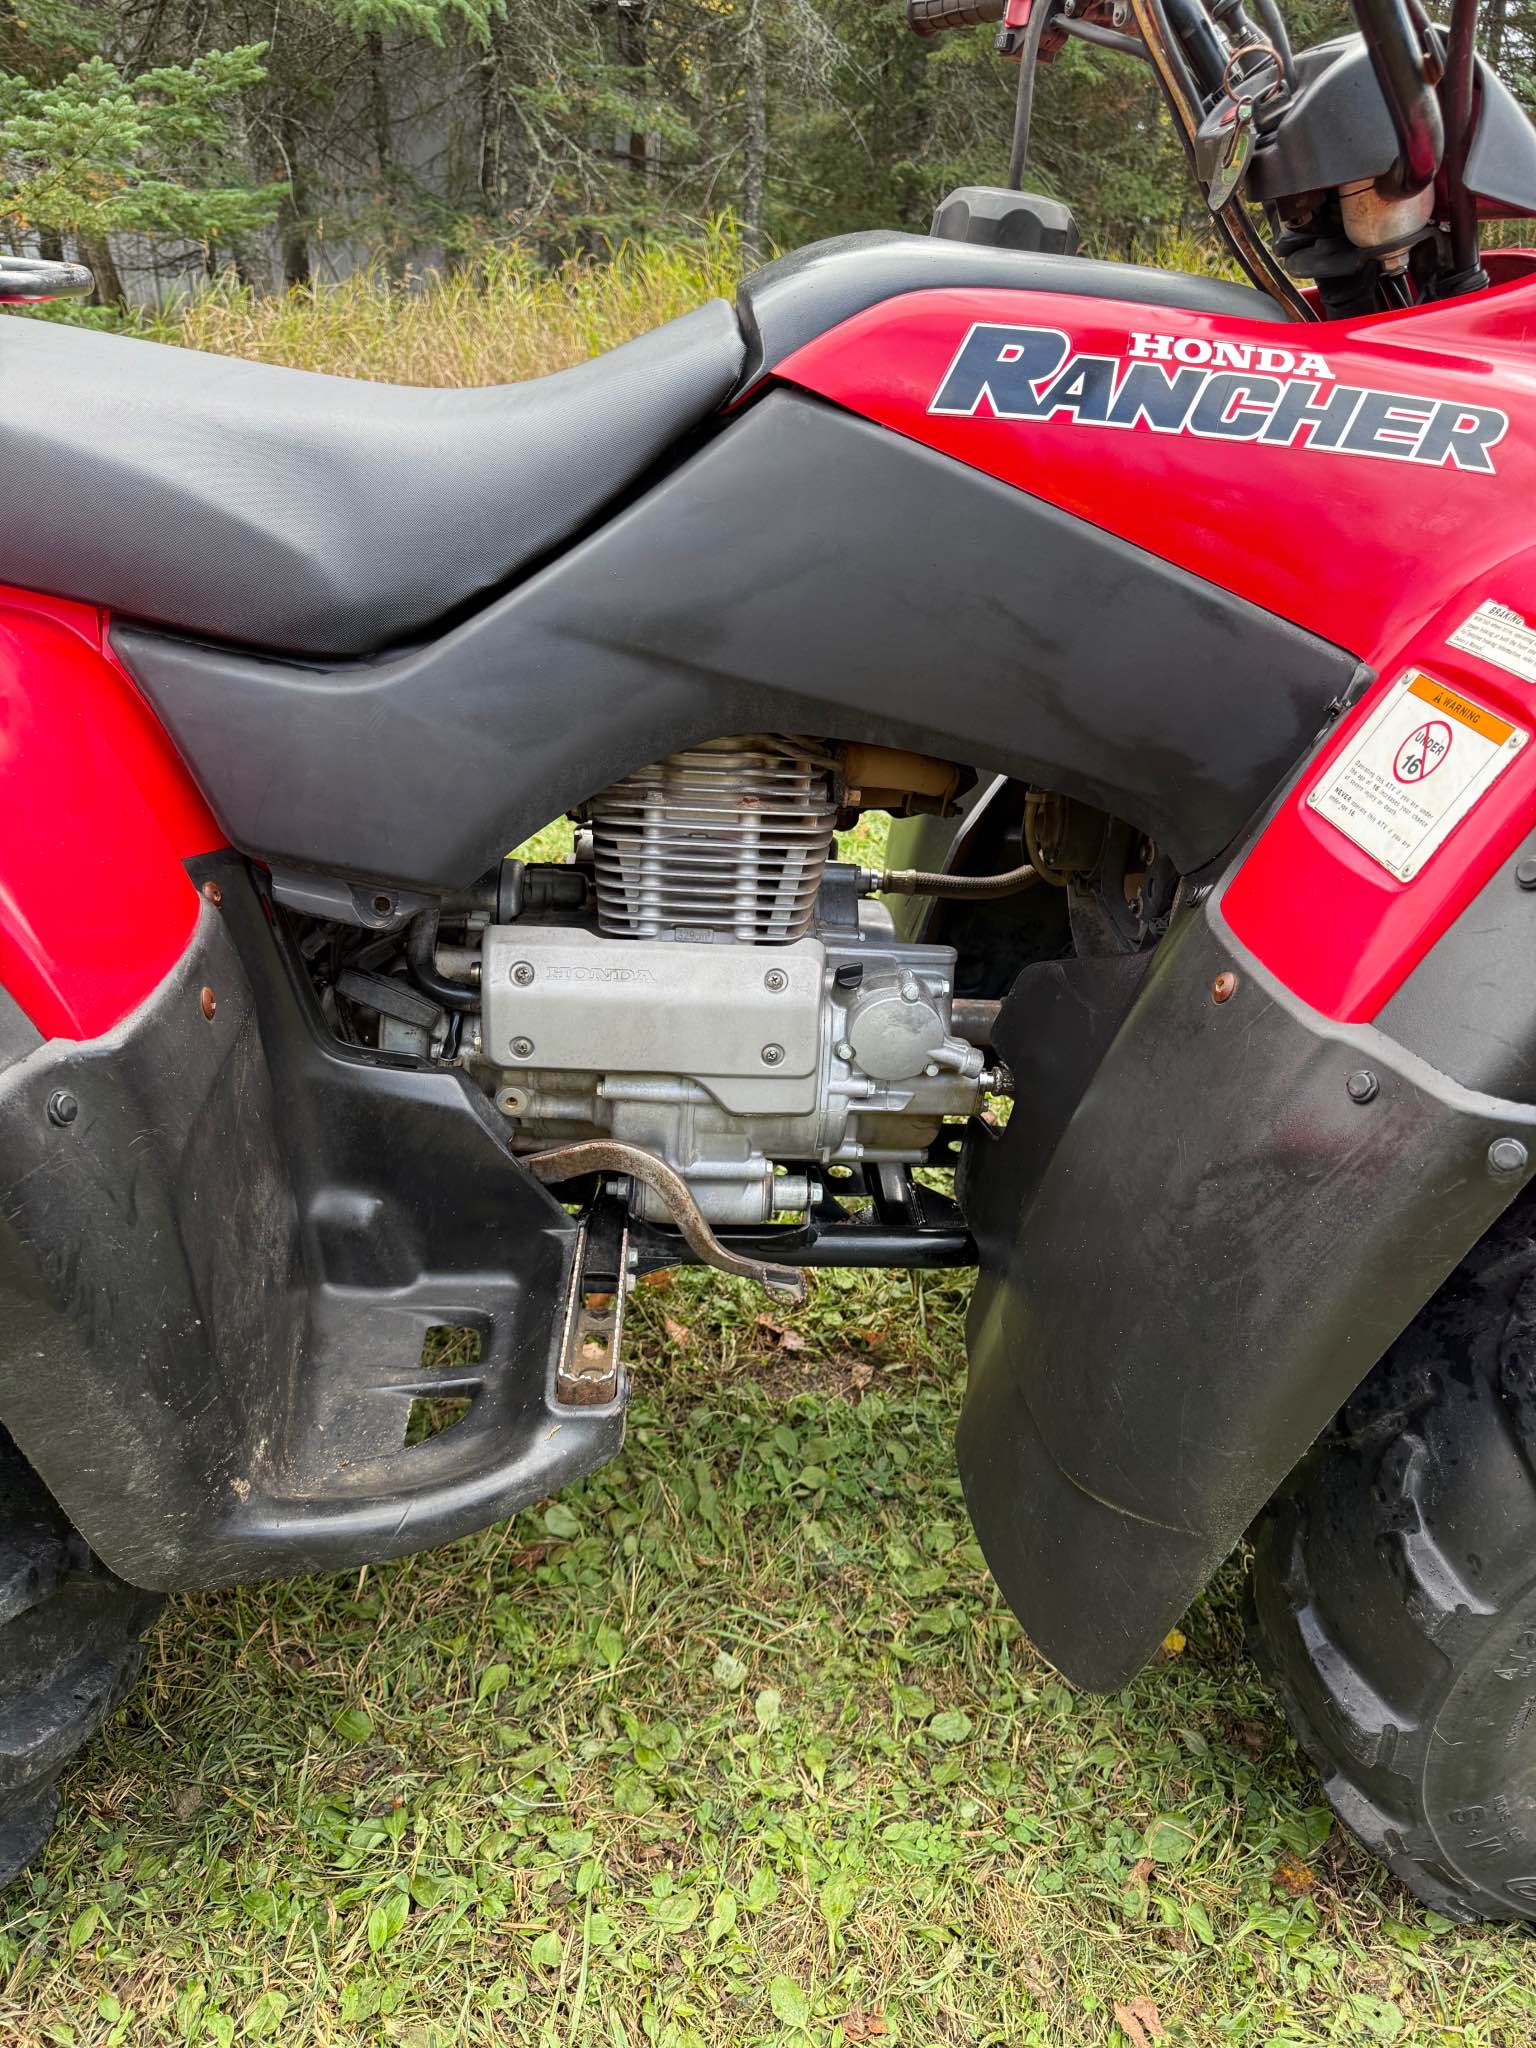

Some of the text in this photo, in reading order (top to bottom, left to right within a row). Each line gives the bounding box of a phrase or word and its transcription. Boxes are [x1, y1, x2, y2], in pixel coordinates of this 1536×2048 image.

[1130, 332, 1336, 380] HONDA
[928, 322, 1510, 475] RANCHER
[1443, 697, 1481, 724] WARNING
[1414, 731, 1445, 757] UNDER
[1401, 754, 1422, 775] 16
[1334, 786, 1352, 802] NEVER
[1385, 781, 1396, 792] ATV
[1379, 789, 1401, 806] increases
[1411, 812, 1429, 827] chance
[546, 966, 656, 983] HONDA
